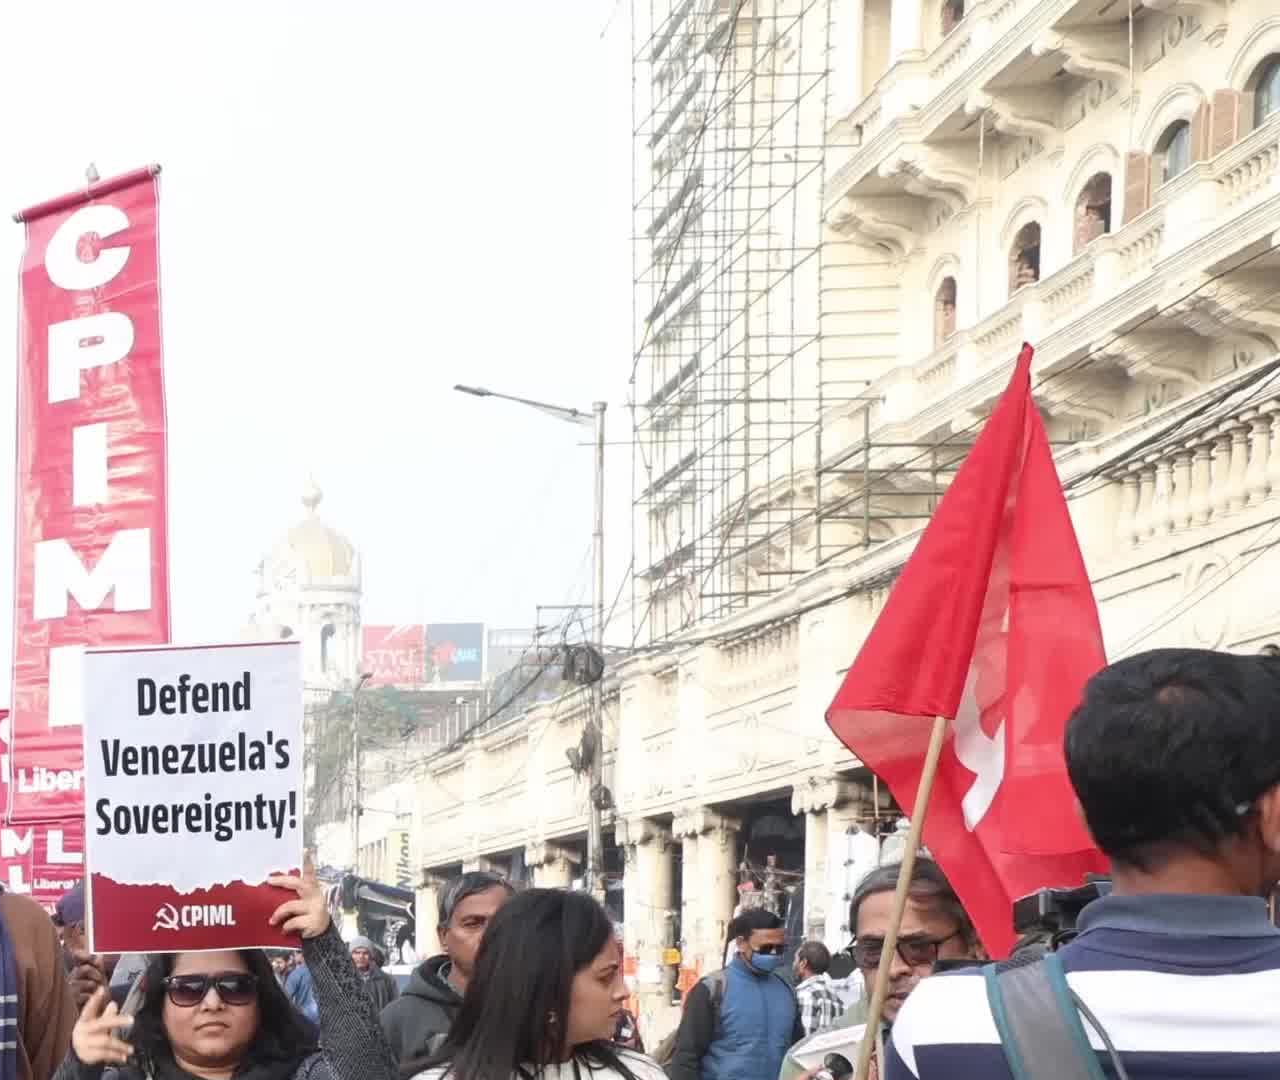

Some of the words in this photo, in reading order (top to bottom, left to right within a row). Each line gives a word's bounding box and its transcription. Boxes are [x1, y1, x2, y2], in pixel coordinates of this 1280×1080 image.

[137, 671, 252, 717] Defend
[100, 730, 291, 778] Venezuela's
[95, 790, 298, 843] Sovereignty!
[180, 903, 237, 928] CPIML
